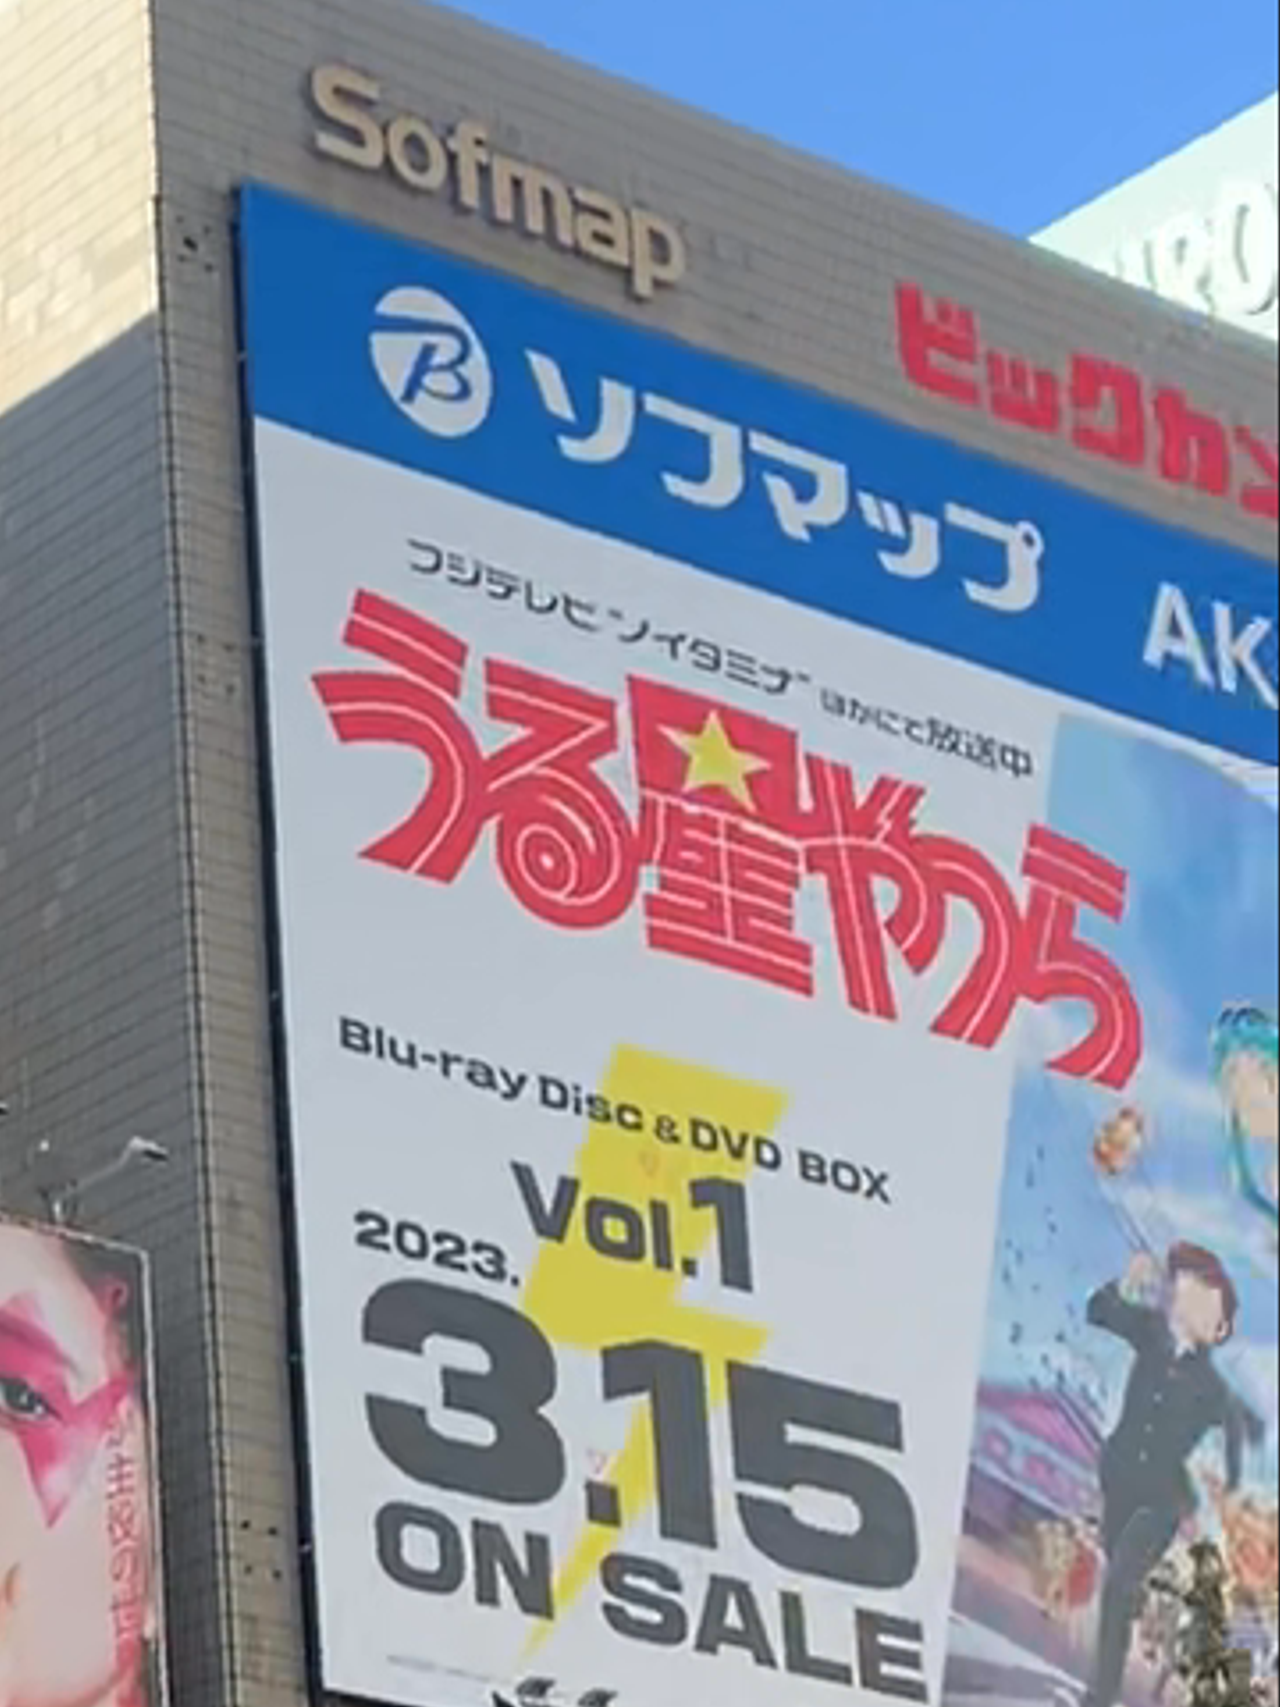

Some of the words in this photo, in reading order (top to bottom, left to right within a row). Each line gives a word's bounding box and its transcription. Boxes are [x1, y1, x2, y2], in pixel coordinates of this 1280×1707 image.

[310, 62, 687, 297] Sofmap
[524, 348, 1045, 613] ソフマップ
[311, 588, 1142, 1091] うる星やつら
[339, 1016, 528, 1104] Blu-ray
[539, 1074, 643, 1132] Disc
[653, 1112, 682, 1146] &
[689, 1116, 783, 1172] DVD
[797, 1149, 891, 1206] BOX
[351, 1210, 522, 1288] 2023.
[510, 1159, 754, 1294] Vol.1
[361, 1276, 921, 1591] 3.15
[373, 1500, 556, 1621] ON
[597, 1551, 929, 1705] SALE
